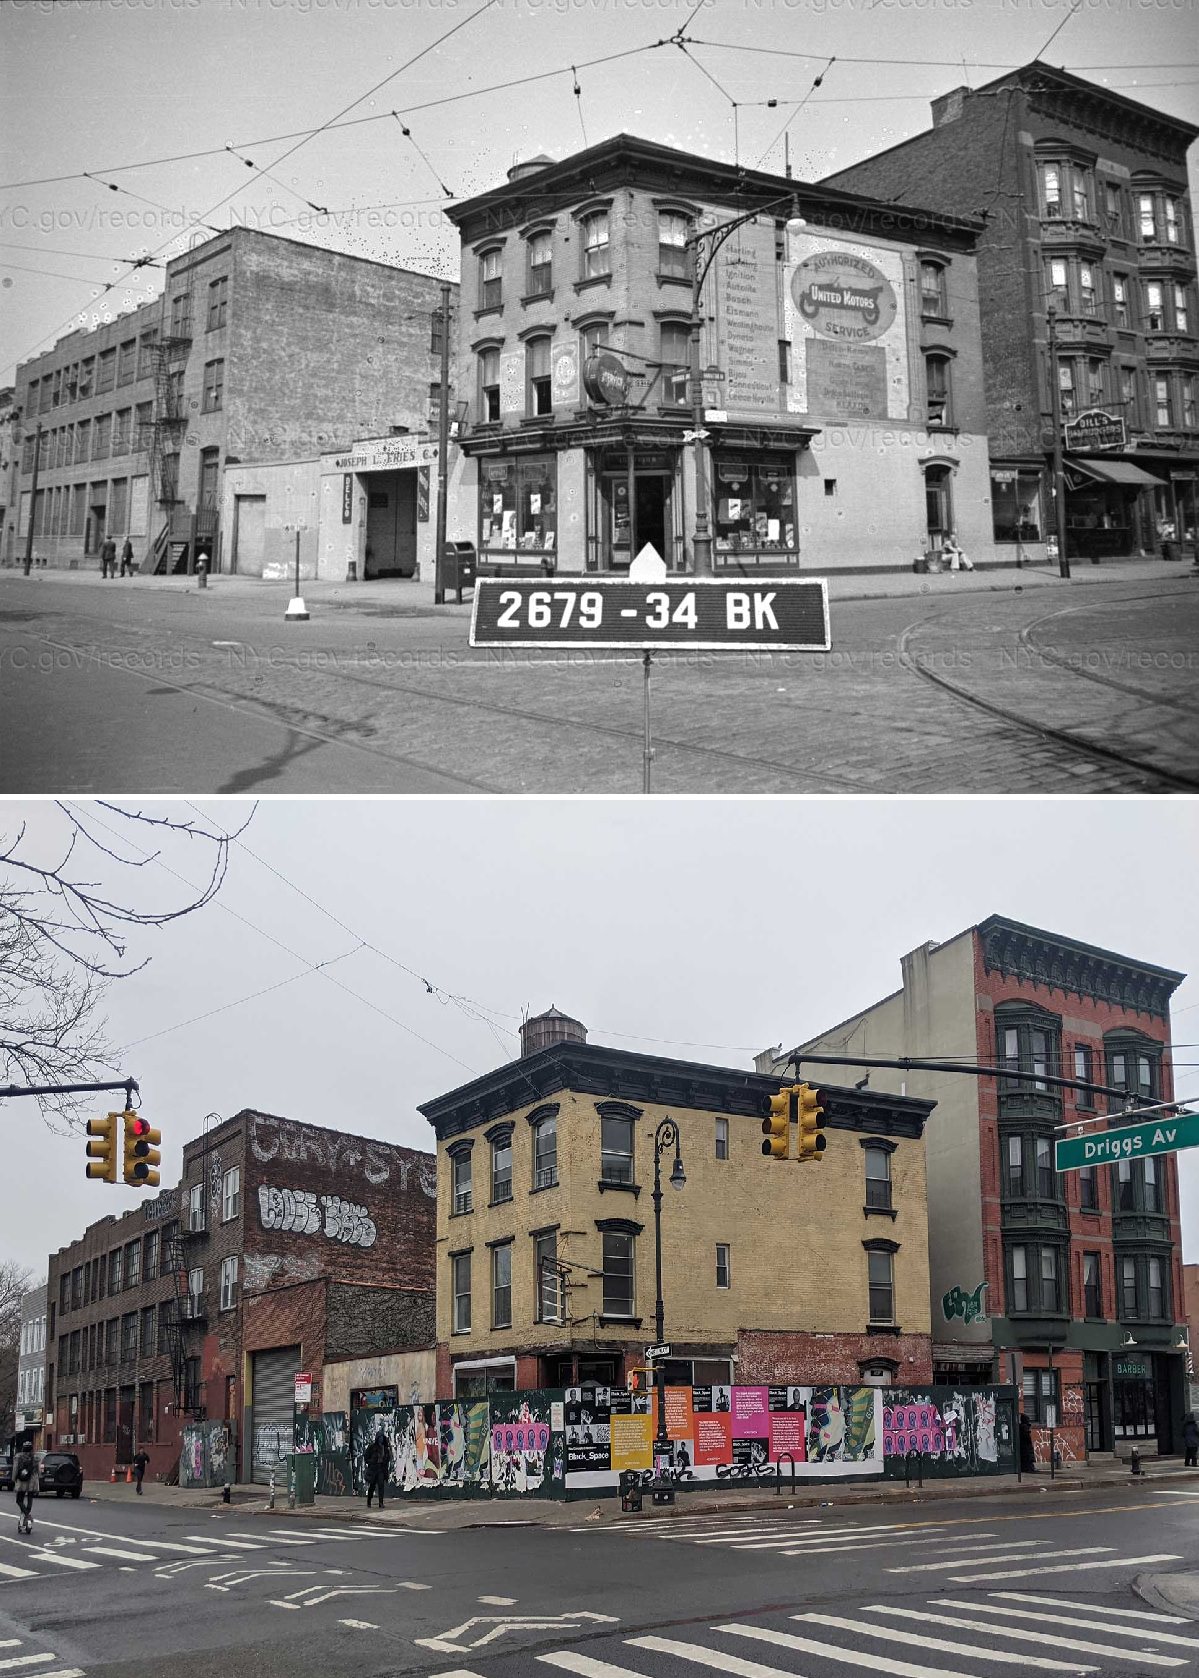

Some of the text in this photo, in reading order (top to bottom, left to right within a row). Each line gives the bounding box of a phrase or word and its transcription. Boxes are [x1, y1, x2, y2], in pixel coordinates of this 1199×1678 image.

[814, 256, 876, 279] AUTHORIZED
[825, 321, 871, 338] SERVICE
[497, 591, 604, 629] 2679
[726, 592, 780, 630] BK
[1084, 1128, 1177, 1159] Driggs Av
[1117, 1363, 1146, 1374] BARBER
[568, 1451, 610, 1461] Black_Space
